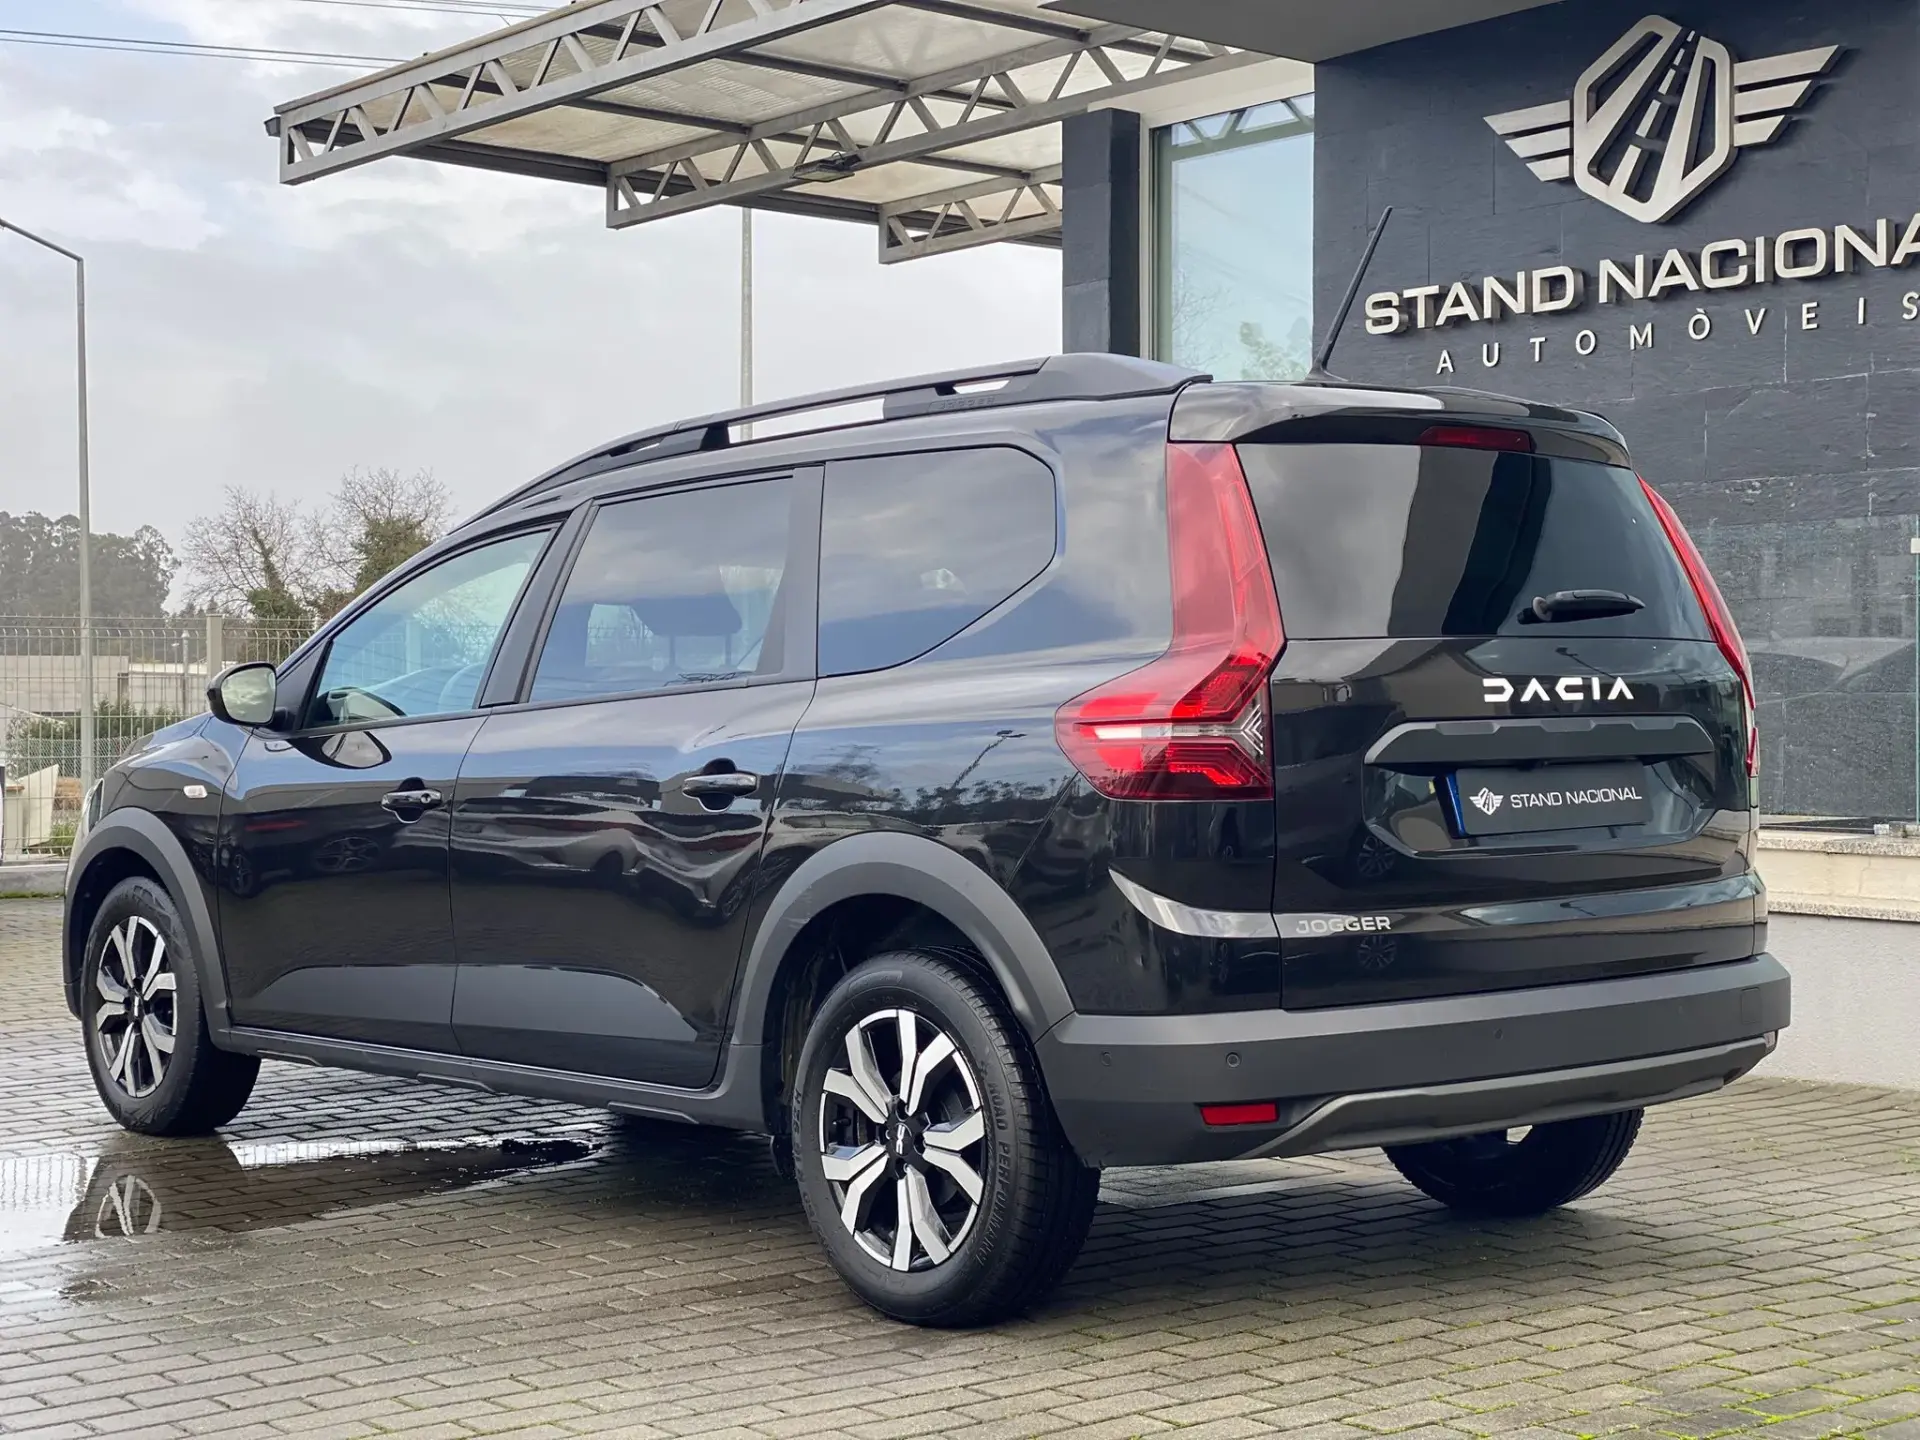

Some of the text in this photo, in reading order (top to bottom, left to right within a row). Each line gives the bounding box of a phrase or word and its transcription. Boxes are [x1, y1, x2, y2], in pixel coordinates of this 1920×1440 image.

[1364, 265, 1577, 335] STAND
[1482, 676, 1635, 703] DACIA
[1510, 786, 1643, 808] STAND NACIONAL
[1295, 916, 1392, 934] JOGGER
